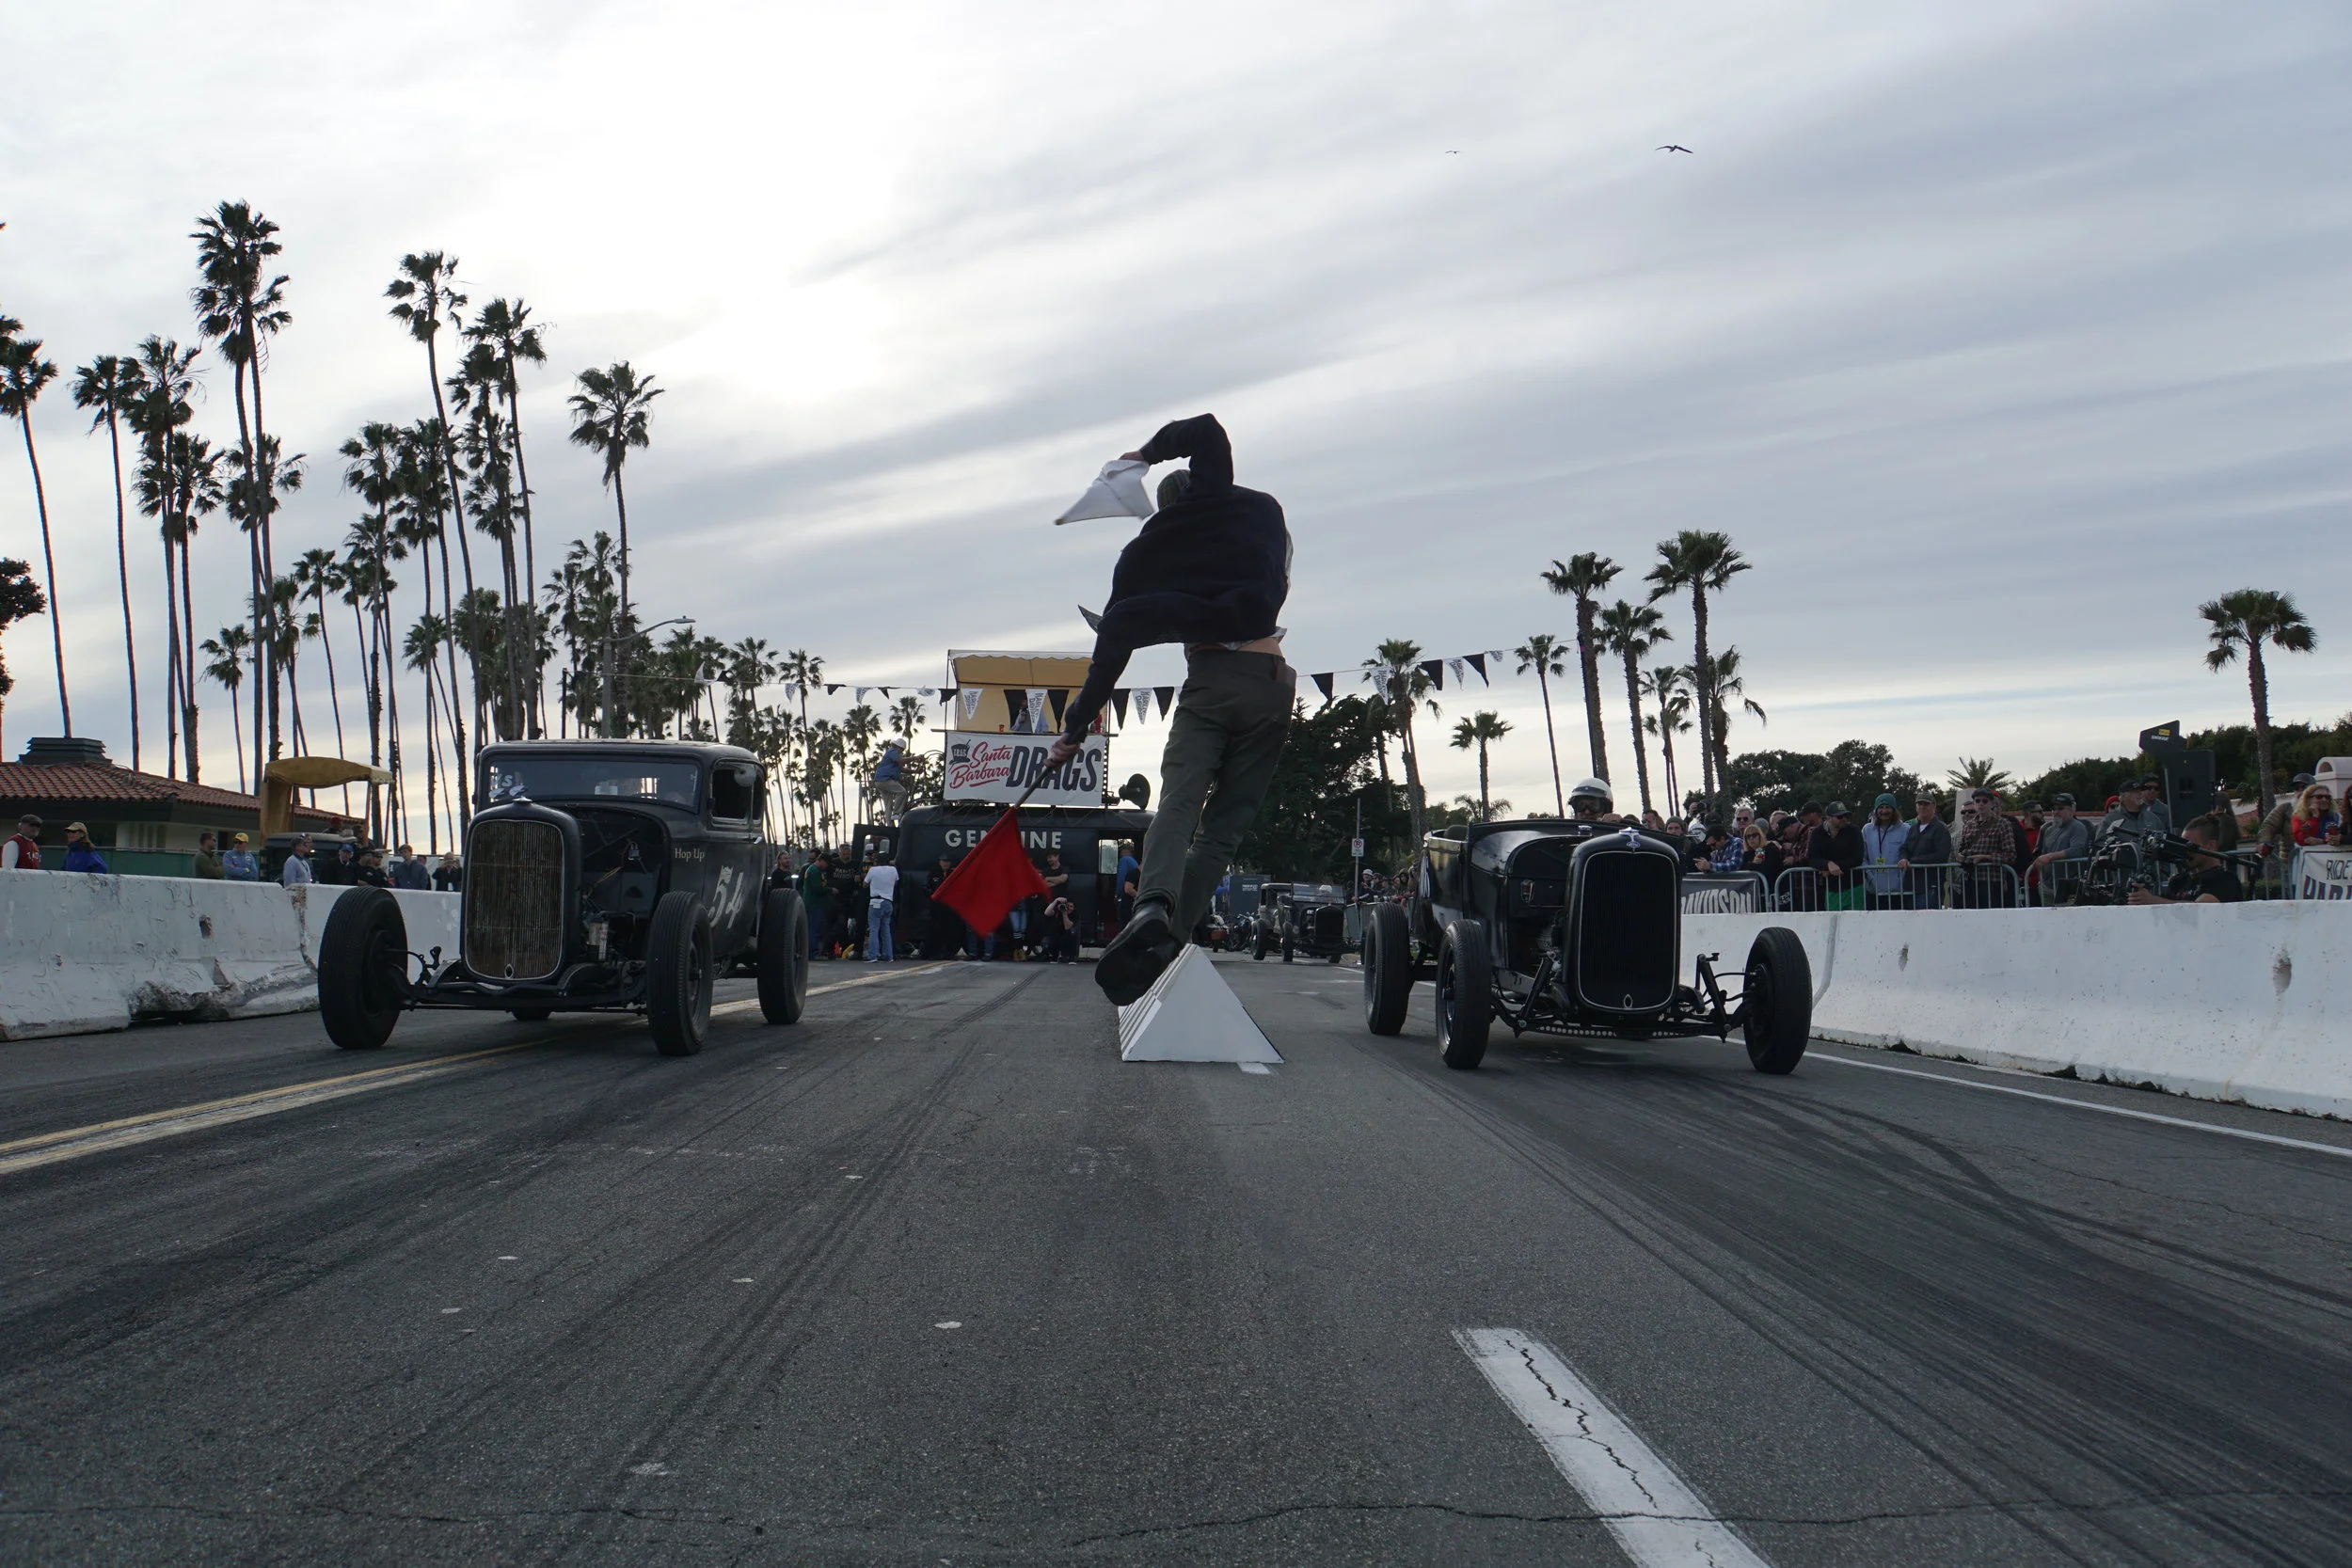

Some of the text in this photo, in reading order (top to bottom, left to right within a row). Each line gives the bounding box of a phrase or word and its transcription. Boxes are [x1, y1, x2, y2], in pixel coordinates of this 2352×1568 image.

[970, 741, 1013, 768] Santa
[949, 762, 1011, 789] Barbara
[945, 829, 1062, 849] GEINE
[675, 847, 705, 863] Hop Up
